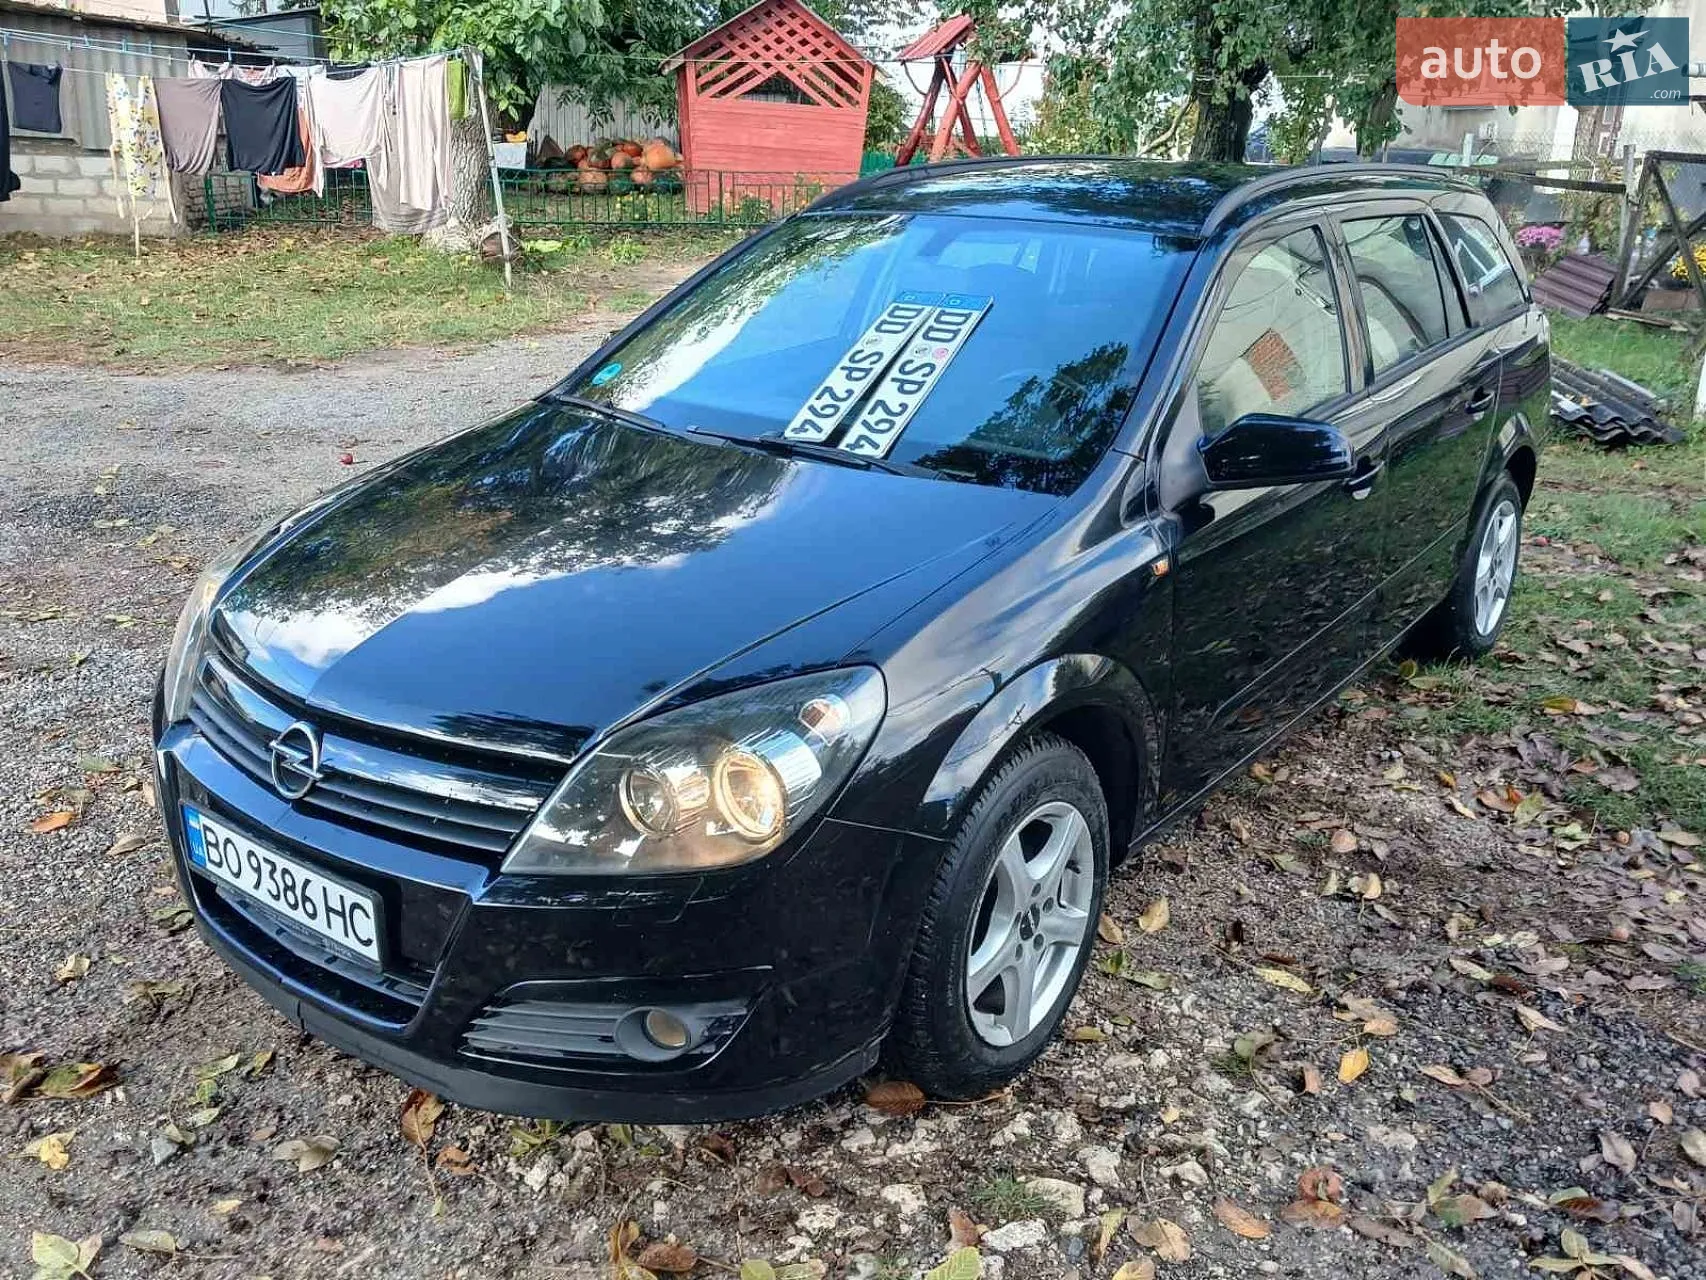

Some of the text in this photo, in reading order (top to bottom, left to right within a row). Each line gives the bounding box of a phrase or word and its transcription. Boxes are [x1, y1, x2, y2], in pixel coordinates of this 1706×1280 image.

[791, 305, 924, 434] DD SP 294
[846, 310, 972, 451] DD SP 294
[202, 823, 242, 879] BO
[247, 849, 318, 920] 9386
[323, 886, 373, 947] HC
